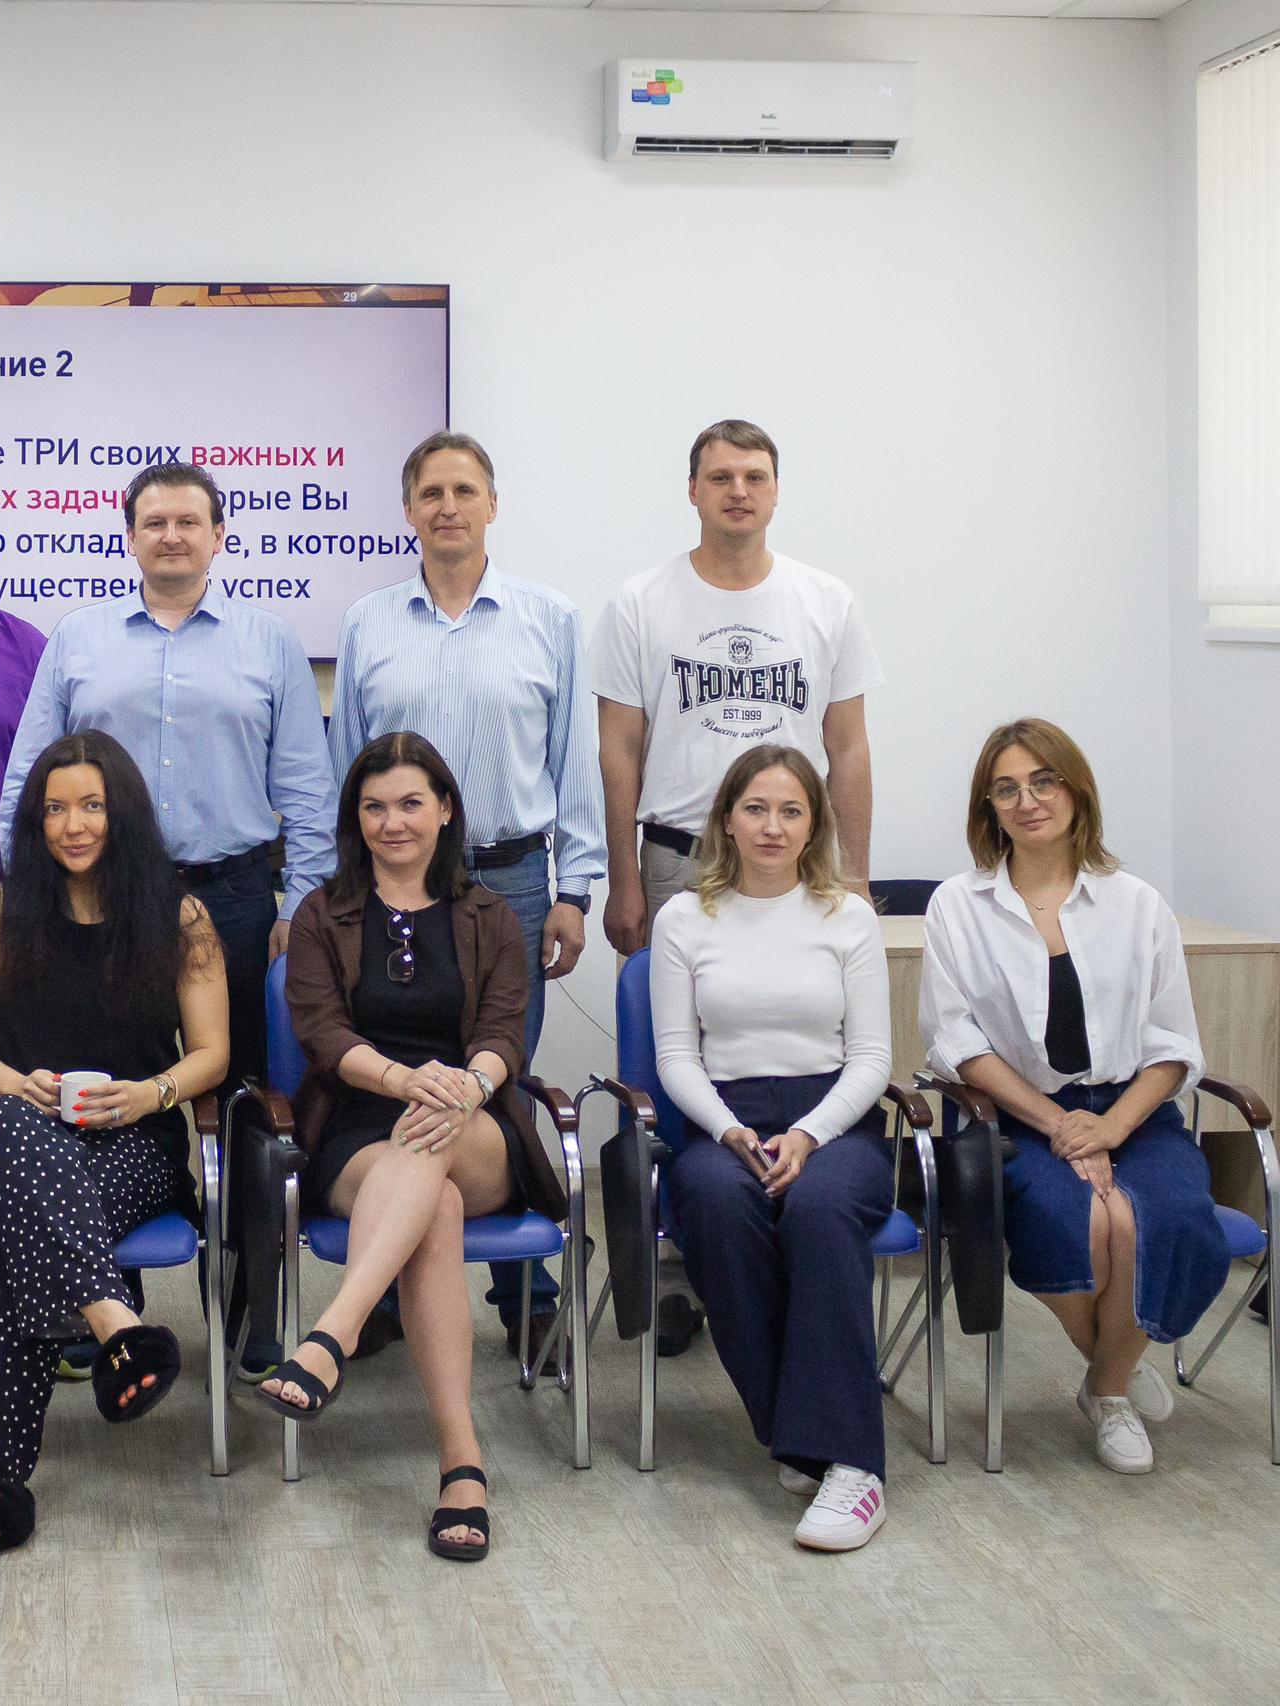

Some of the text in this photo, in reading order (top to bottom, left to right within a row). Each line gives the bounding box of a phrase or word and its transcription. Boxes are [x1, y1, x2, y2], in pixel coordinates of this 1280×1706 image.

[343, 291, 357, 302] 29
[55, 349, 74, 378] 2
[14, 437, 79, 465] ТРИ
[89, 445, 181, 466] своих
[191, 446, 317, 467] важных
[327, 446, 345, 467] и
[26, 489, 126, 514] задач
[302, 482, 348, 511] Вы
[261, 534, 277, 554] в
[288, 534, 420, 562] которых
[221, 578, 311, 599] успех
[671, 654, 809, 714] ТЮМЕНЬ
